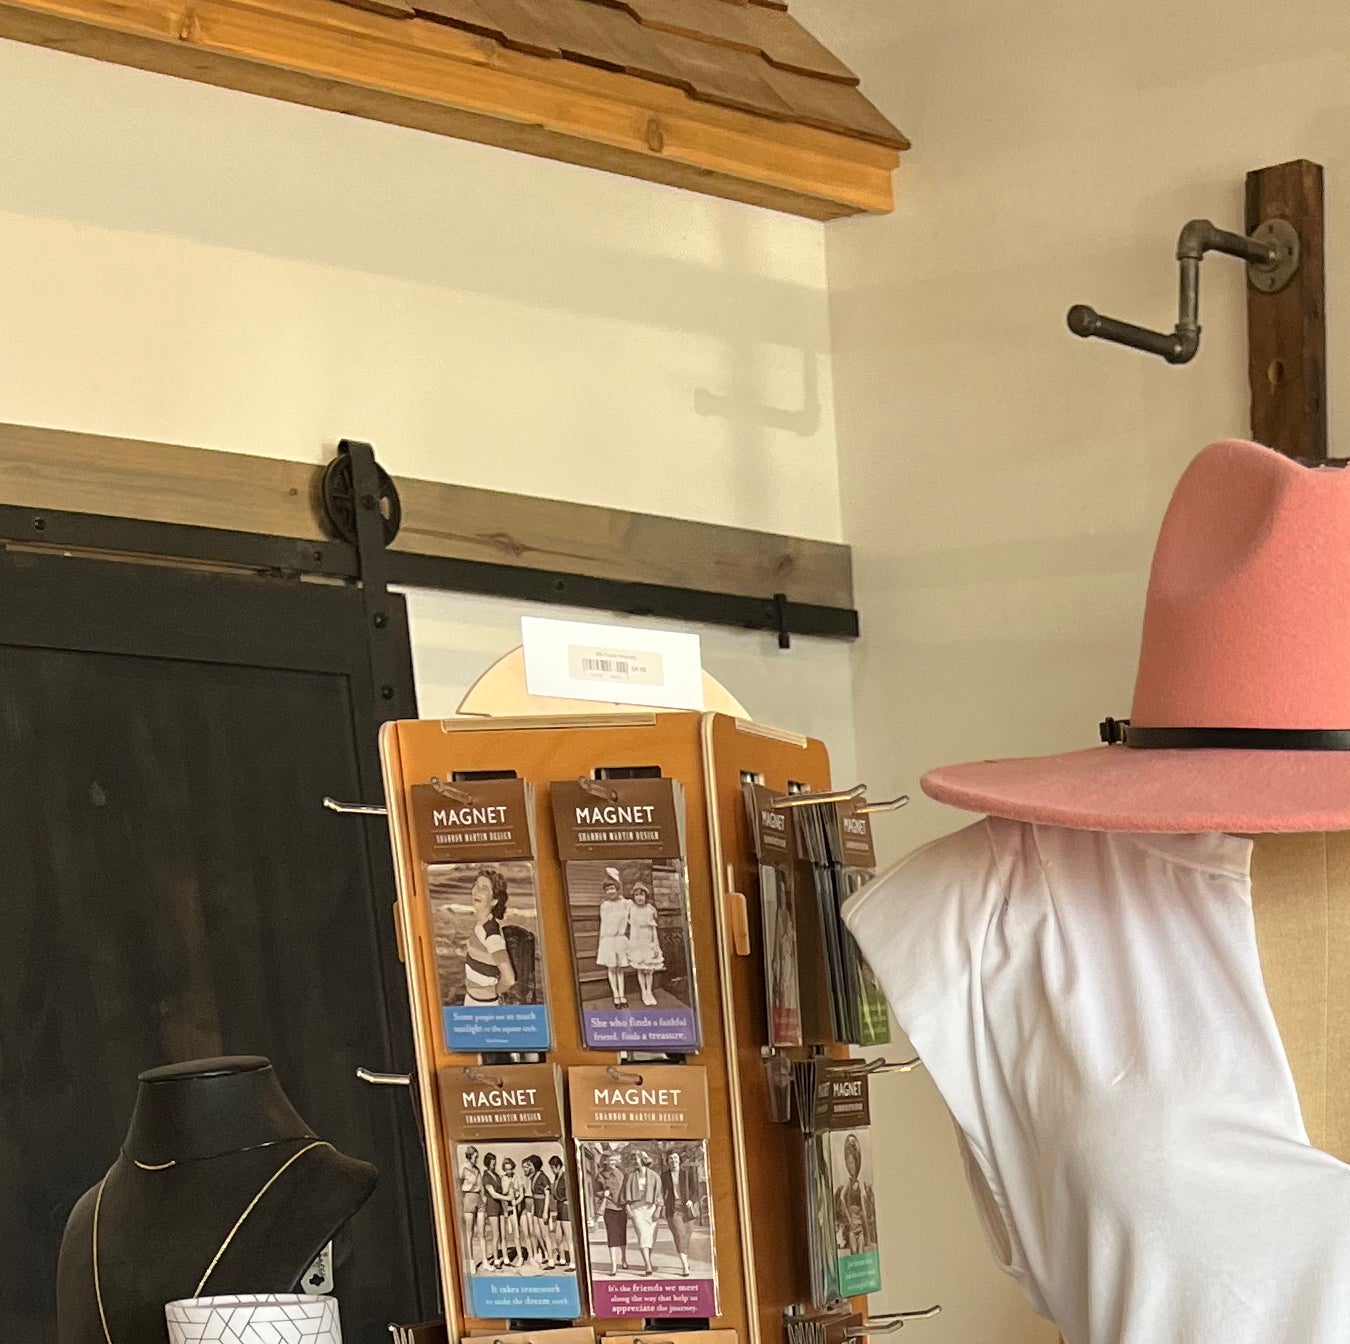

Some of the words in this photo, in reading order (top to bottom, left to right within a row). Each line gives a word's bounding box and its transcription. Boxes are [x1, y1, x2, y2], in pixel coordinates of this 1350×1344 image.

[433, 806, 507, 826] MAGNET
[575, 806, 655, 824] MAGNET
[591, 1018, 607, 1028] She
[610, 1018, 627, 1027] who
[629, 1017, 651, 1027] finds
[594, 1088, 682, 1105] MAGNET
[832, 1081, 862, 1097] MAGNET
[462, 1089, 537, 1107] MAGNET
[632, 1283, 663, 1292] friends
[611, 1305, 655, 1314] appreciate
[656, 1304, 668, 1312] the
